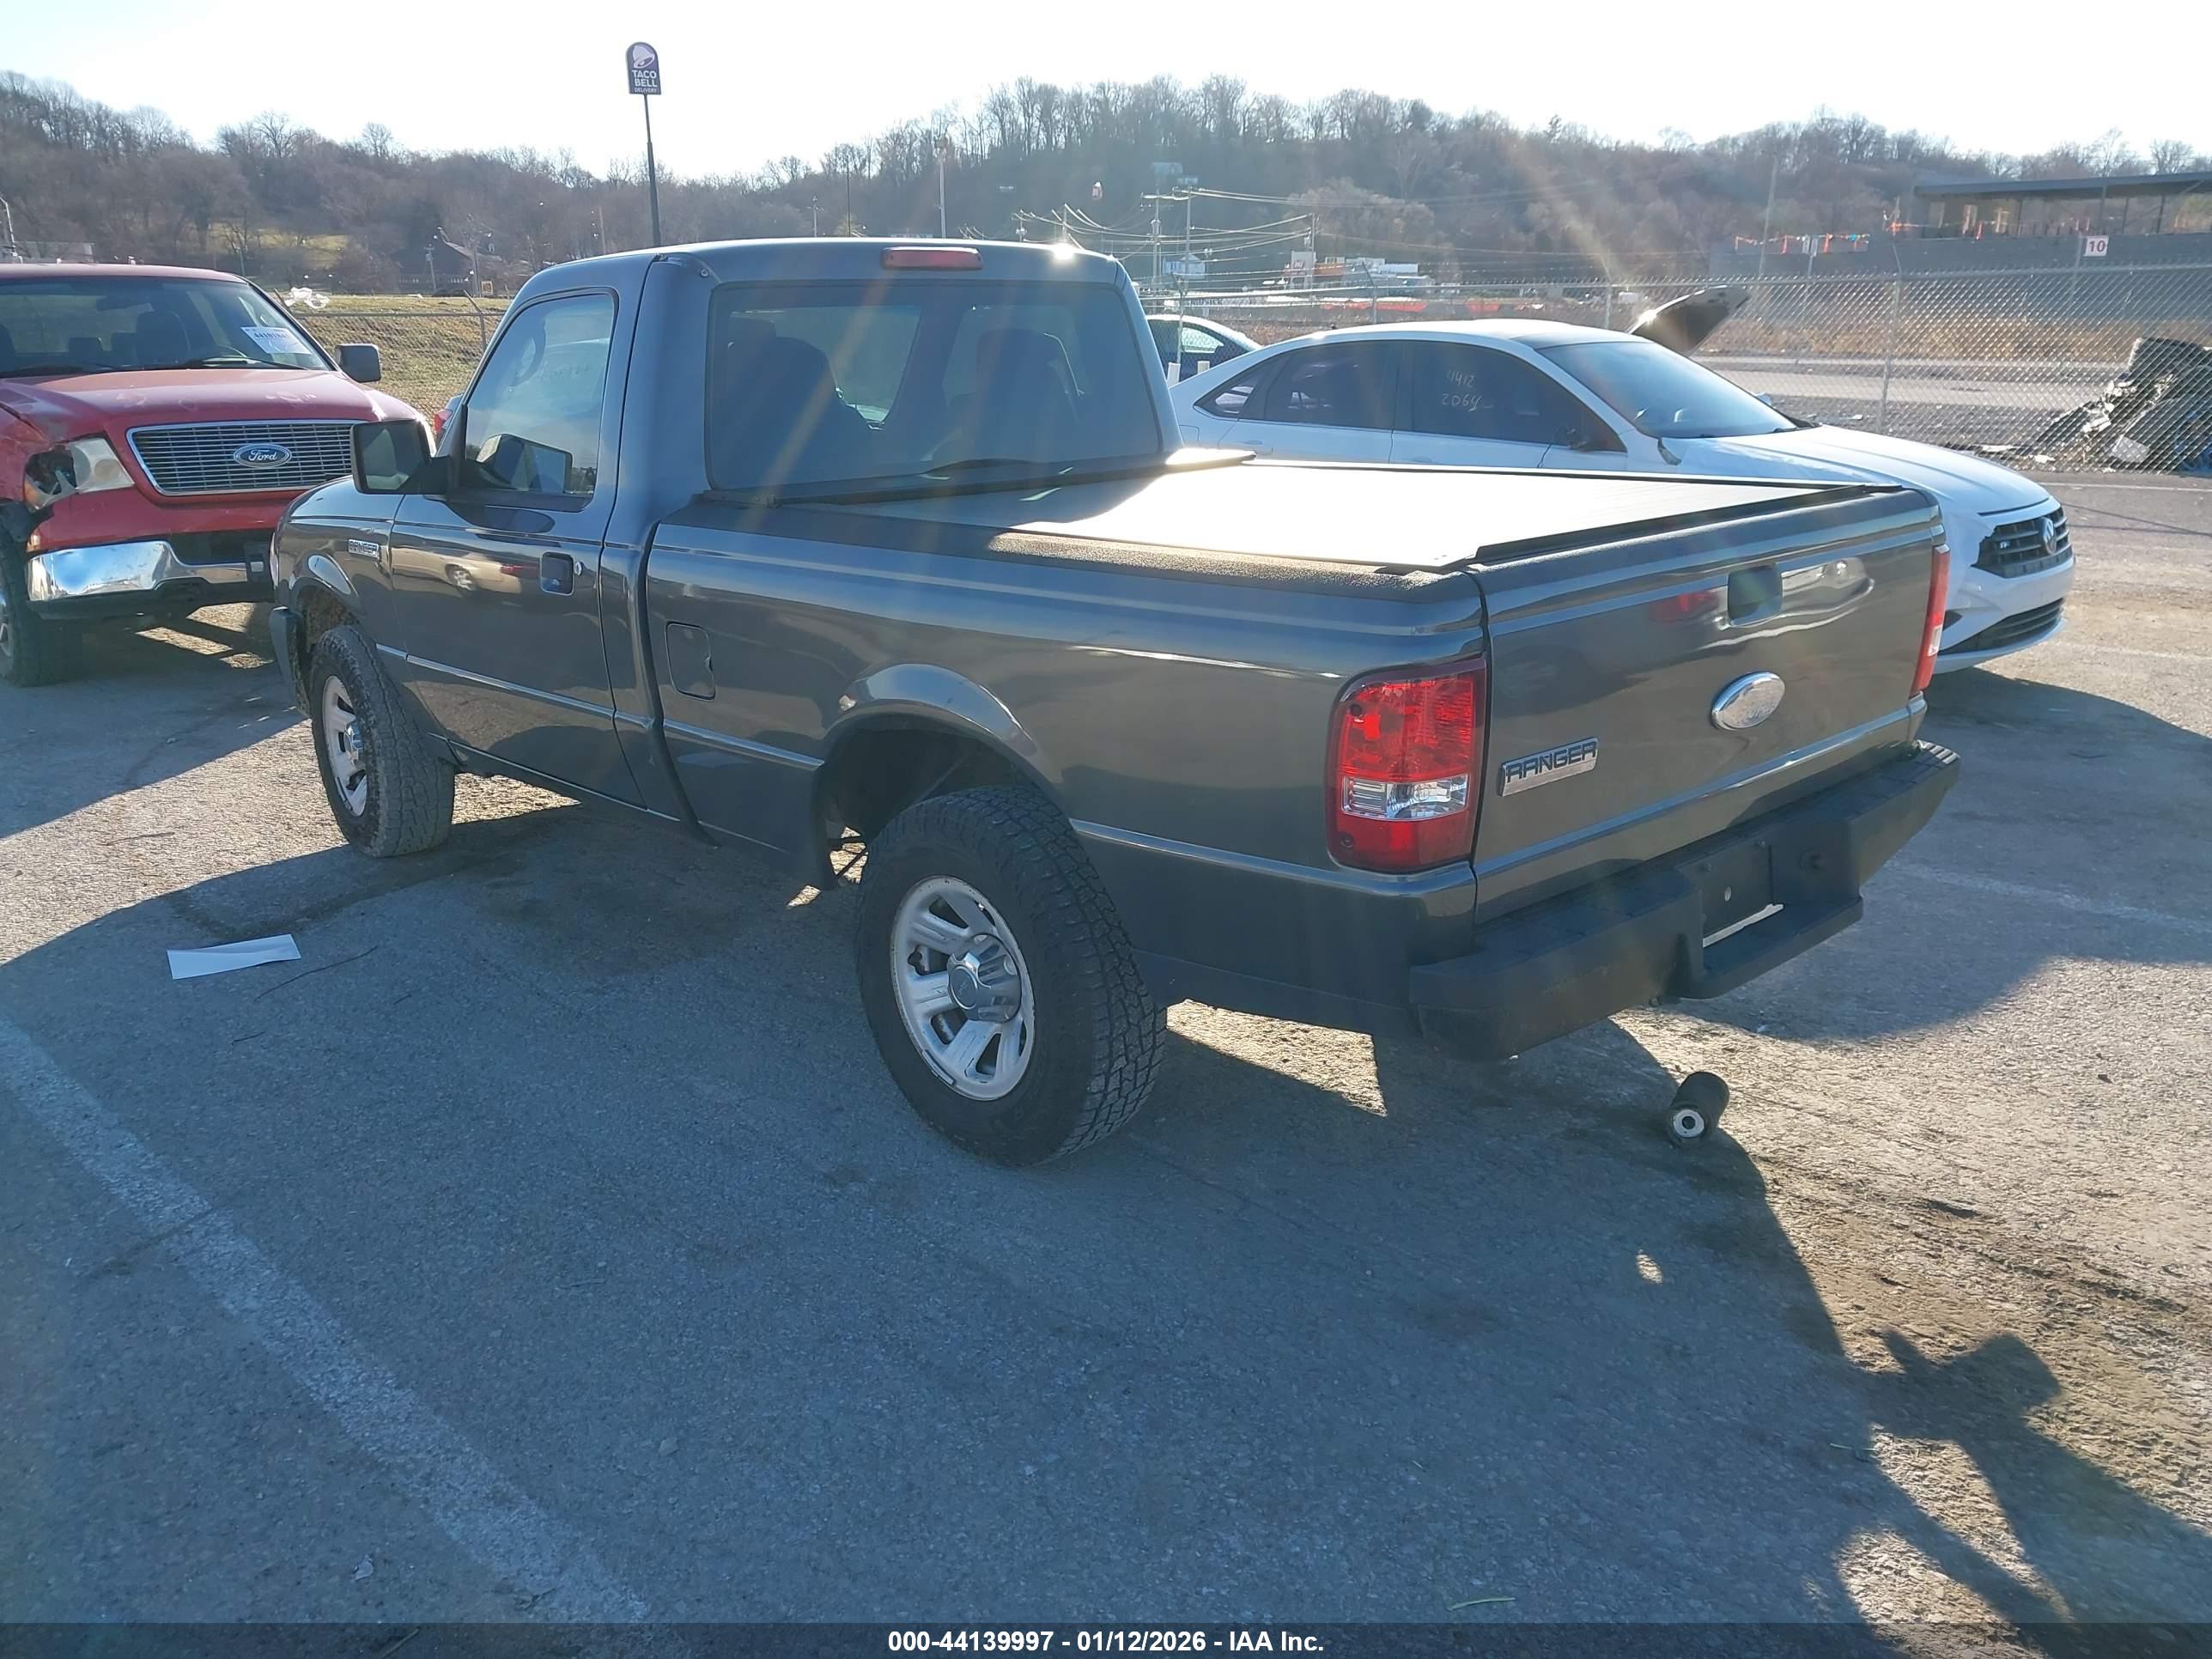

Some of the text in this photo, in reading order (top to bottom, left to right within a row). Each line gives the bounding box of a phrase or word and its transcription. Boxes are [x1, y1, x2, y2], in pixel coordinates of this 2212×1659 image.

[632, 70, 657, 79] TACO
[634, 78, 658, 88] BELL
[2089, 240, 2106, 252] 10
[247, 448, 277, 462] Ford
[349, 540, 378, 554] RANGER
[1506, 740, 1597, 783] RANGER
